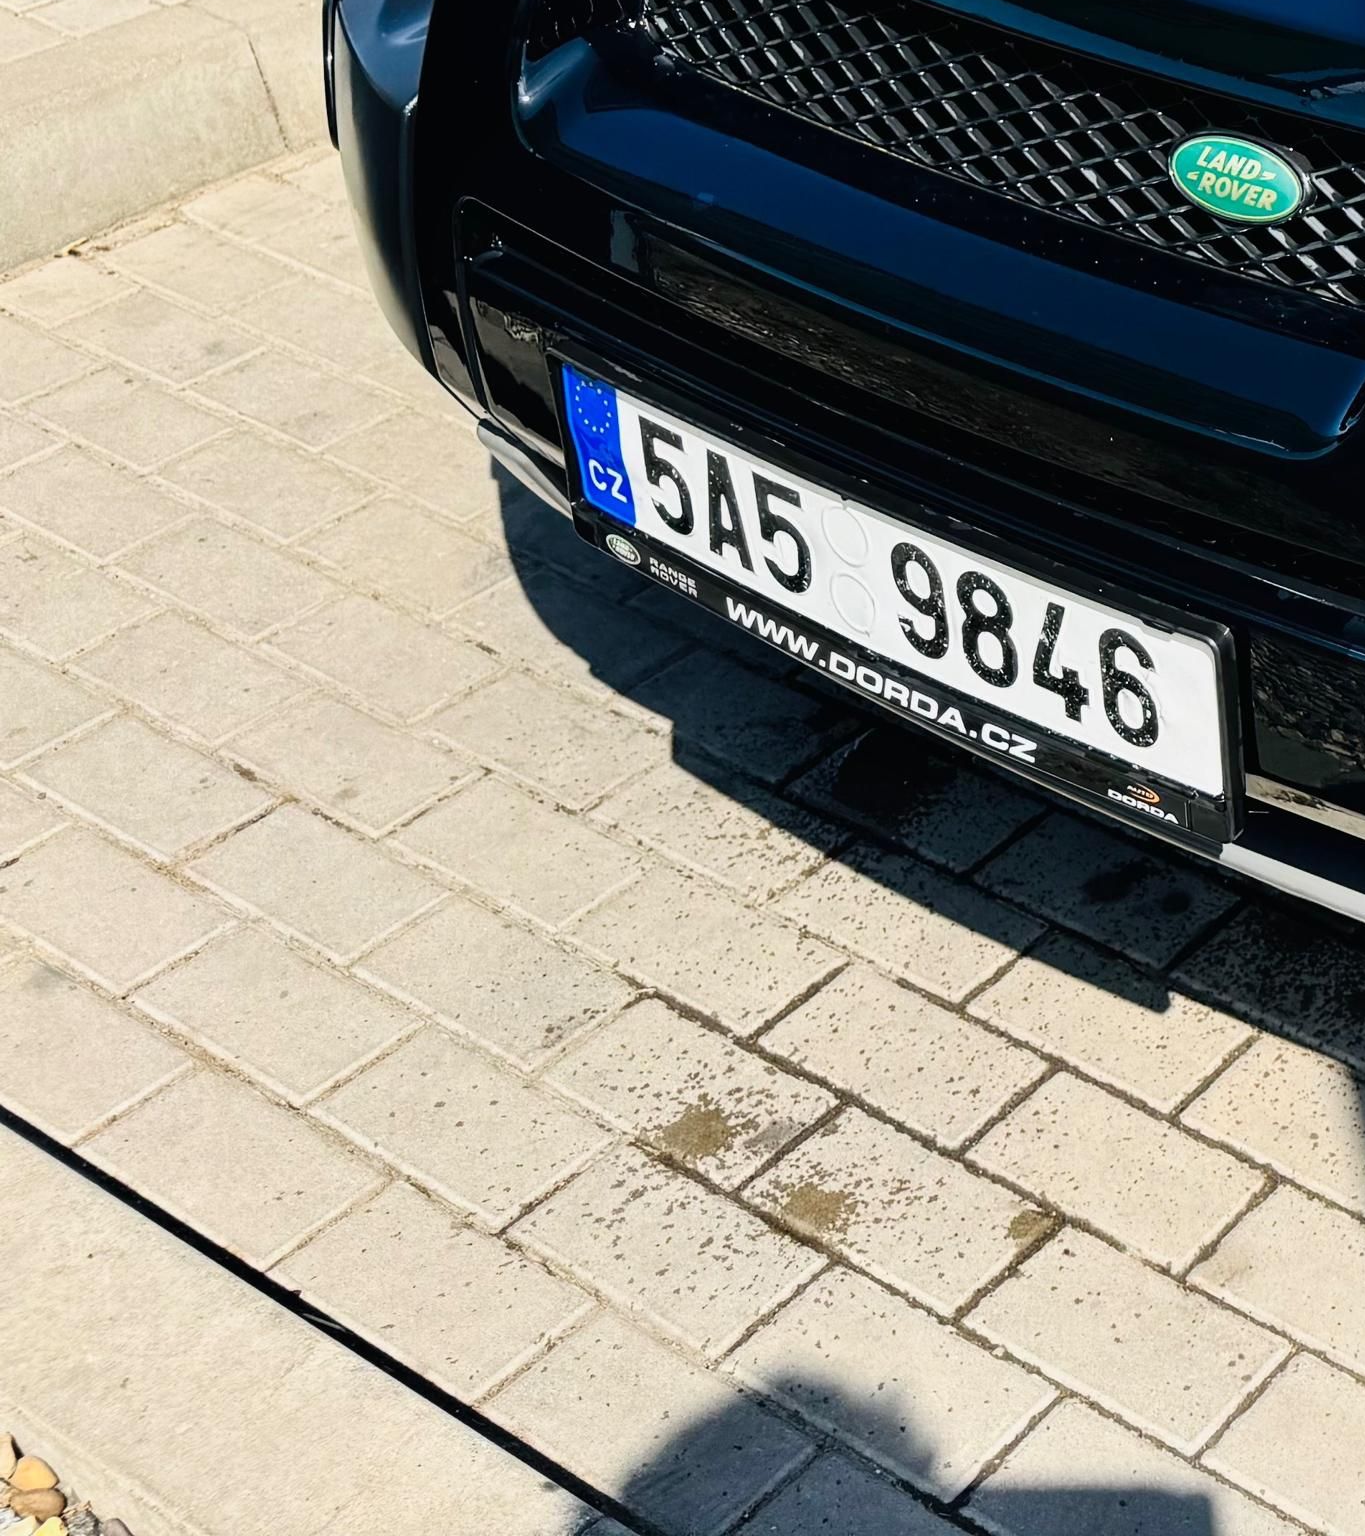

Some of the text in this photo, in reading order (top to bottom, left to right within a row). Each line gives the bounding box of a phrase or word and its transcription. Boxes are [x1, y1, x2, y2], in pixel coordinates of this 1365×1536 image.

[1196, 145, 1262, 181] LAND
[1198, 170, 1278, 211] ROVER
[588, 459, 628, 505] CZ
[636, 414, 1161, 748] 5A5 9846
[649, 557, 697, 588] RANGE
[650, 565, 698, 598] ROVER
[725, 595, 1038, 764] WWW.DORDA.CZ
[1107, 788, 1179, 824] DORDA
